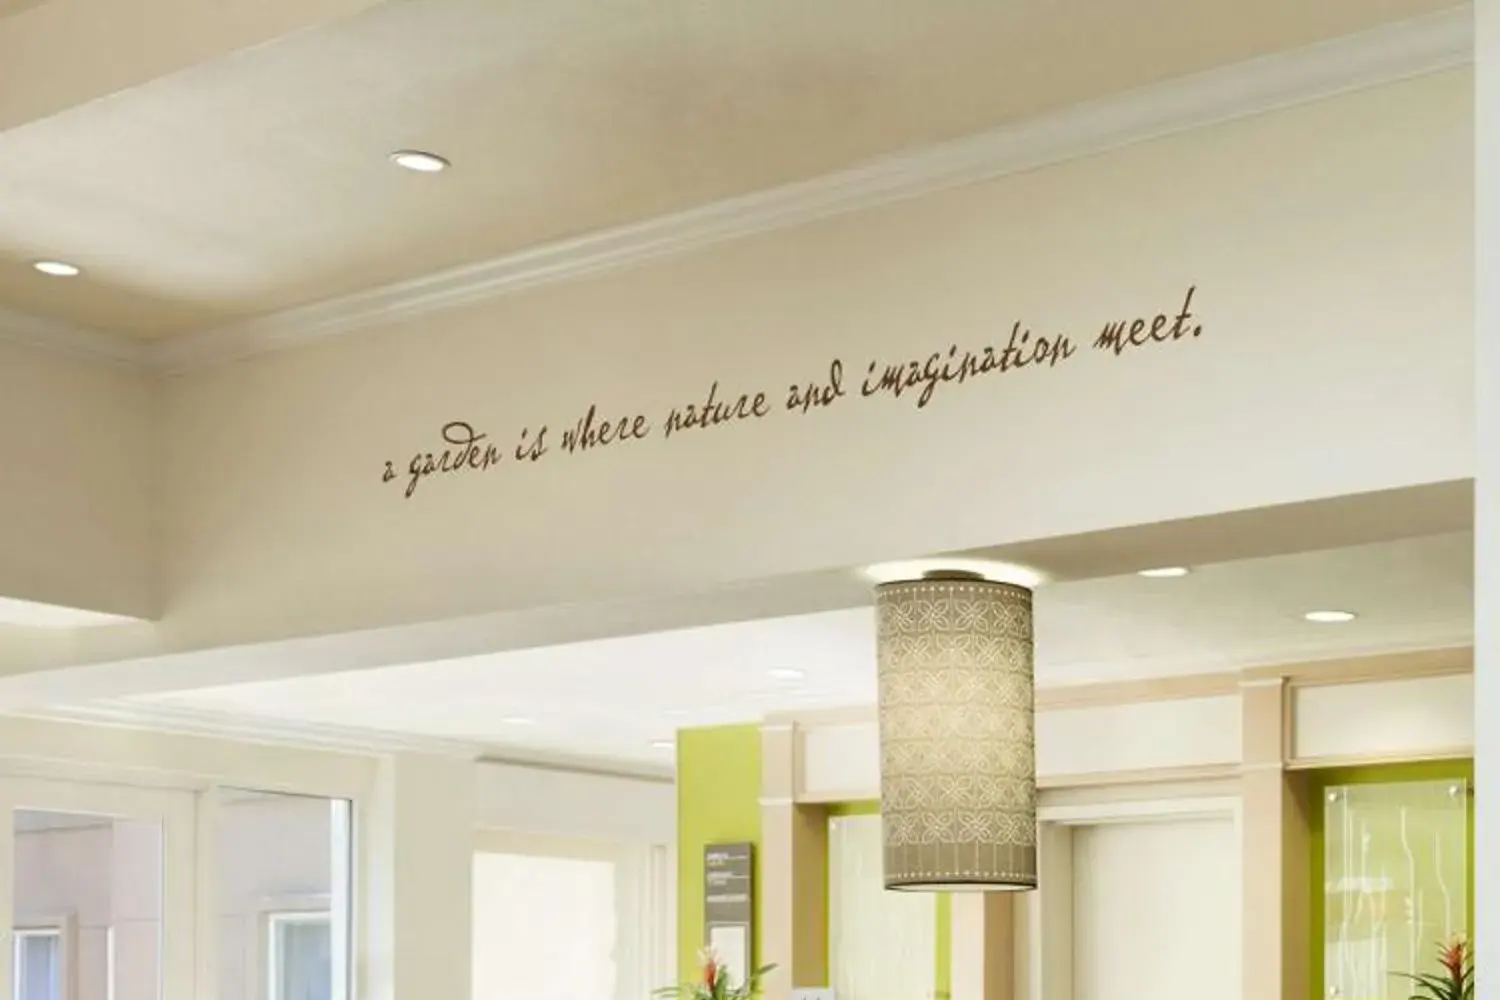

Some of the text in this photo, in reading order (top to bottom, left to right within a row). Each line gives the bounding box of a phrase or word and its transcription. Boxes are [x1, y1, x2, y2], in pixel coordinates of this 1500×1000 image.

[382, 285, 1203, 499] a garden is where nature and imagination meet.
